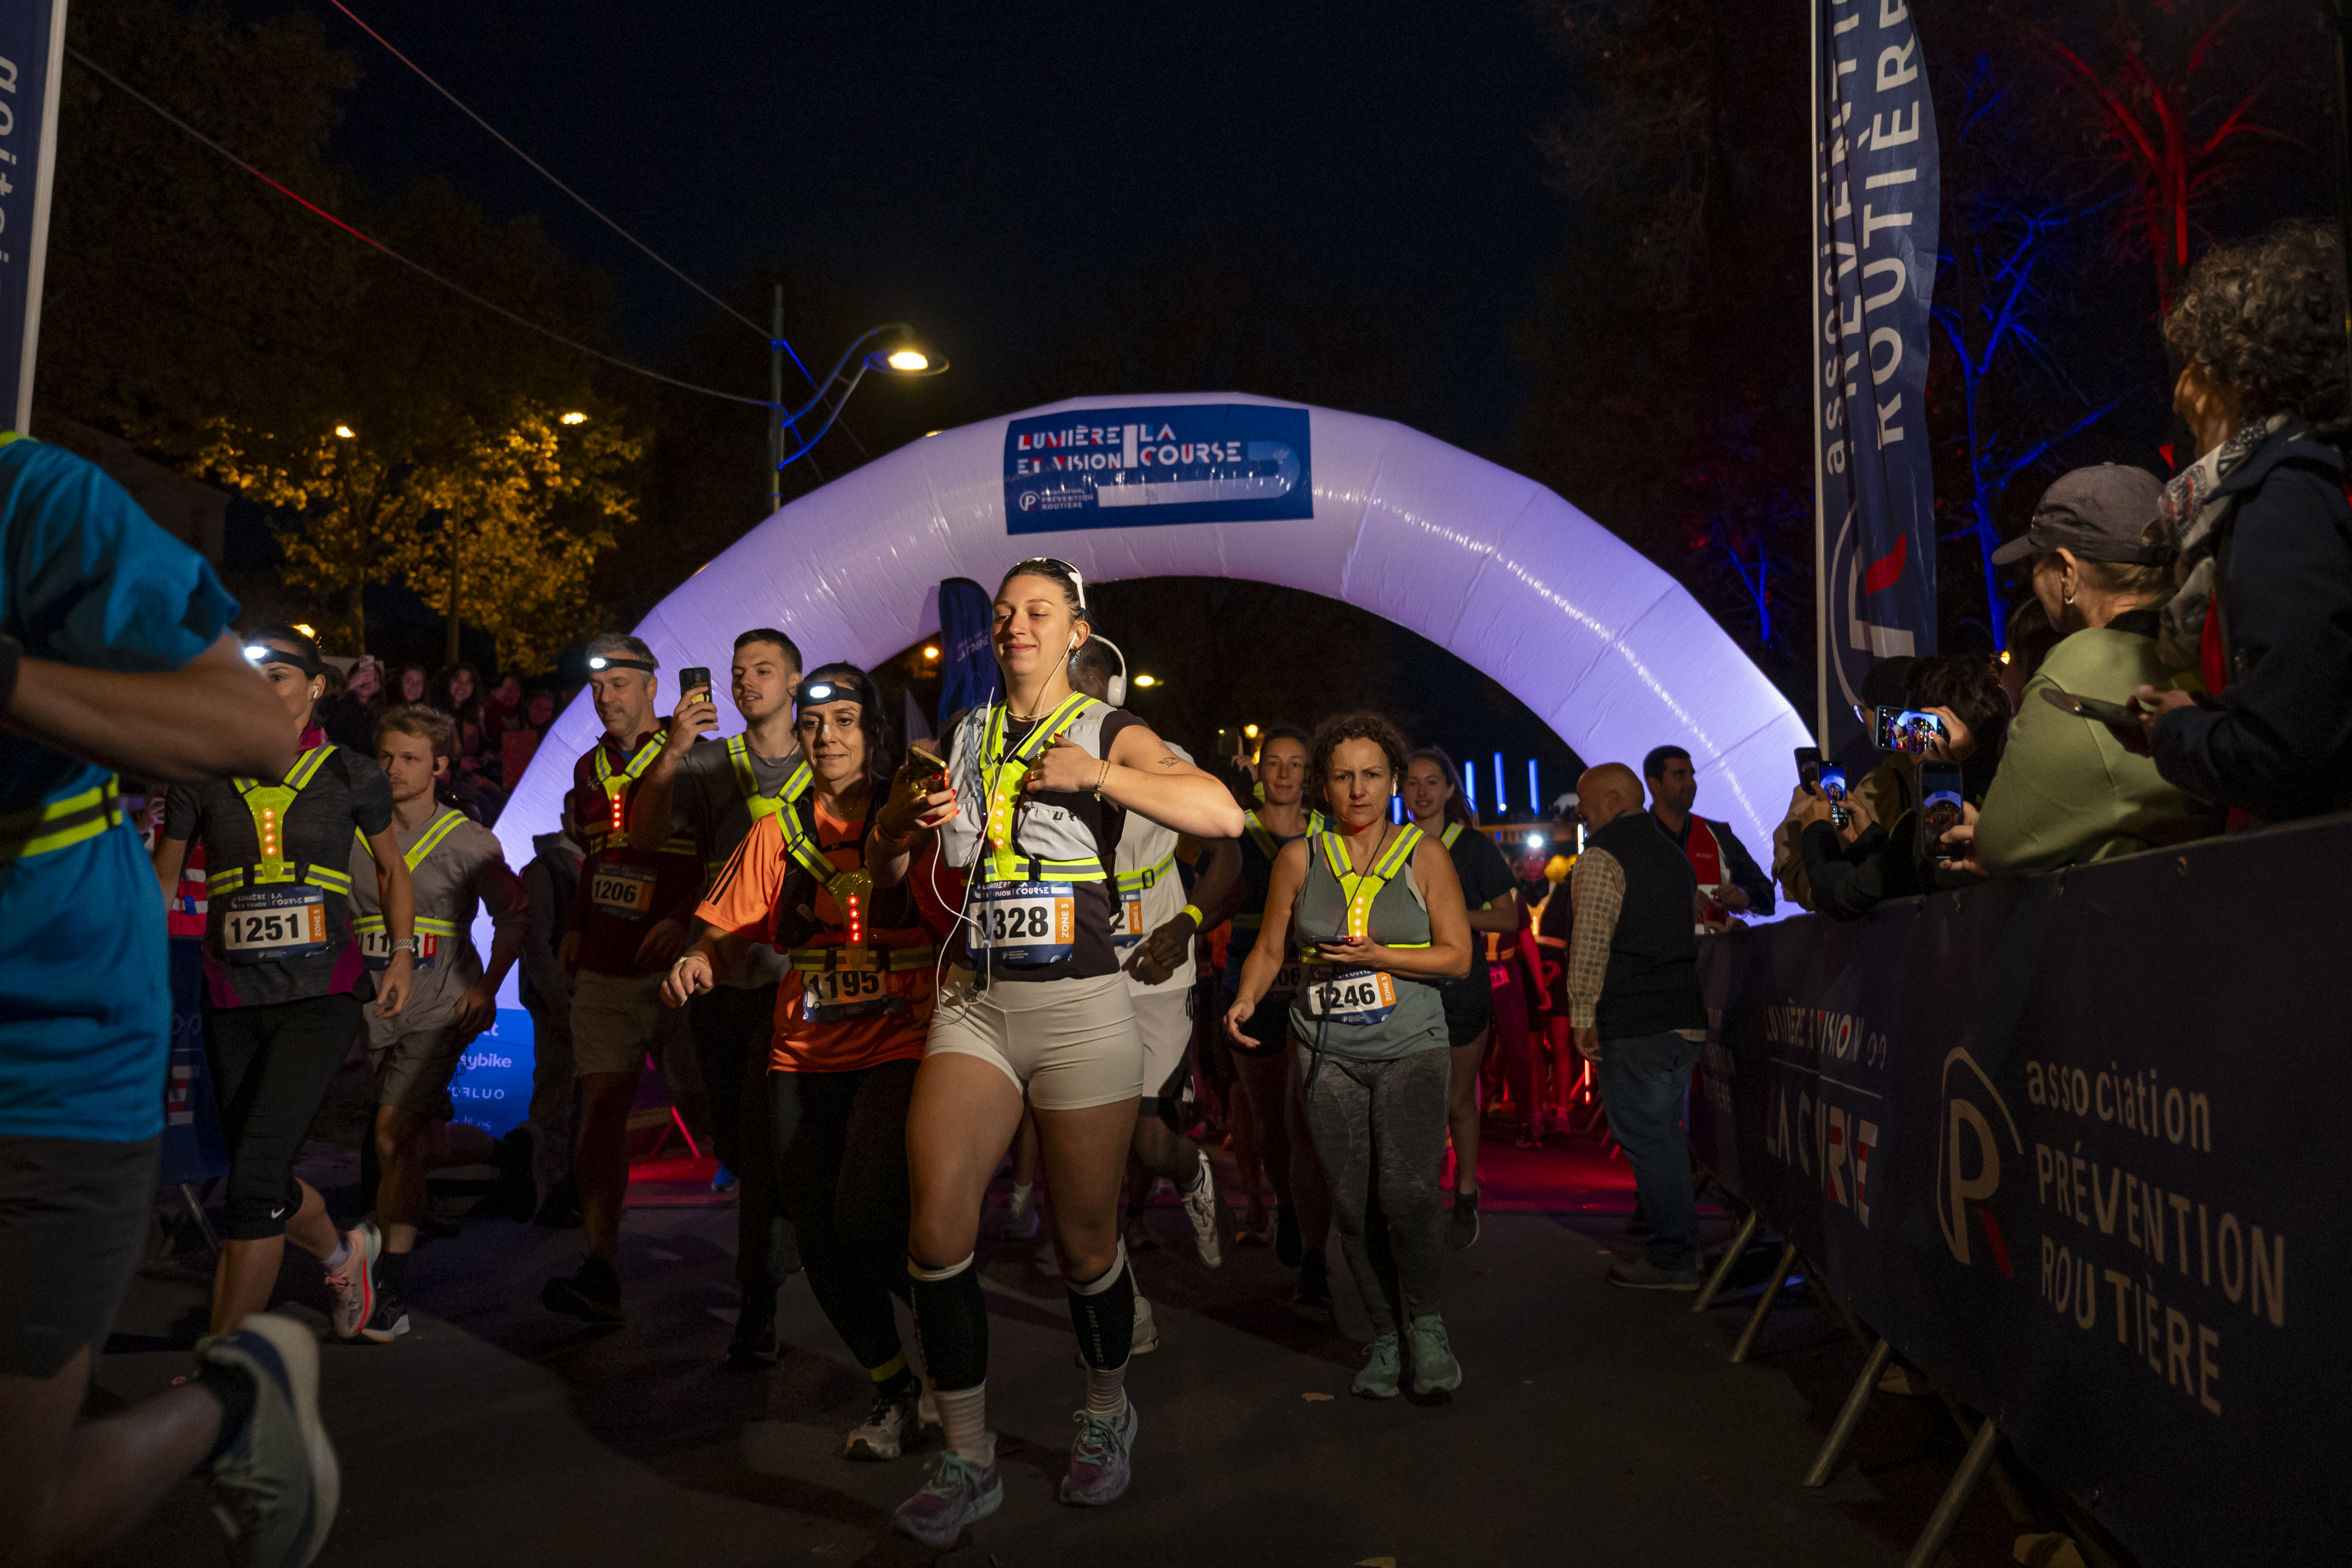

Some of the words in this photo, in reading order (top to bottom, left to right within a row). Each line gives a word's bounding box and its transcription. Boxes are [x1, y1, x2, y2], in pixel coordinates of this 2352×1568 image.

[1018, 424, 1120, 451] LUMIÈRE
[1140, 424, 1176, 442] LA
[1018, 458, 1043, 475] ET
[1052, 453, 1121, 472] VISION
[1140, 441, 1242, 466] COURSE
[595, 880, 638, 903] 1206
[231, 913, 299, 943] 1251
[976, 906, 1049, 940] 1328
[808, 969, 879, 999] 1195
[1315, 982, 1376, 1009] 1246
[1383, 981, 1392, 1002] ZONE
[2026, 1060, 2211, 1153] association
[2035, 1141, 2284, 1328] PRÉVENTION
